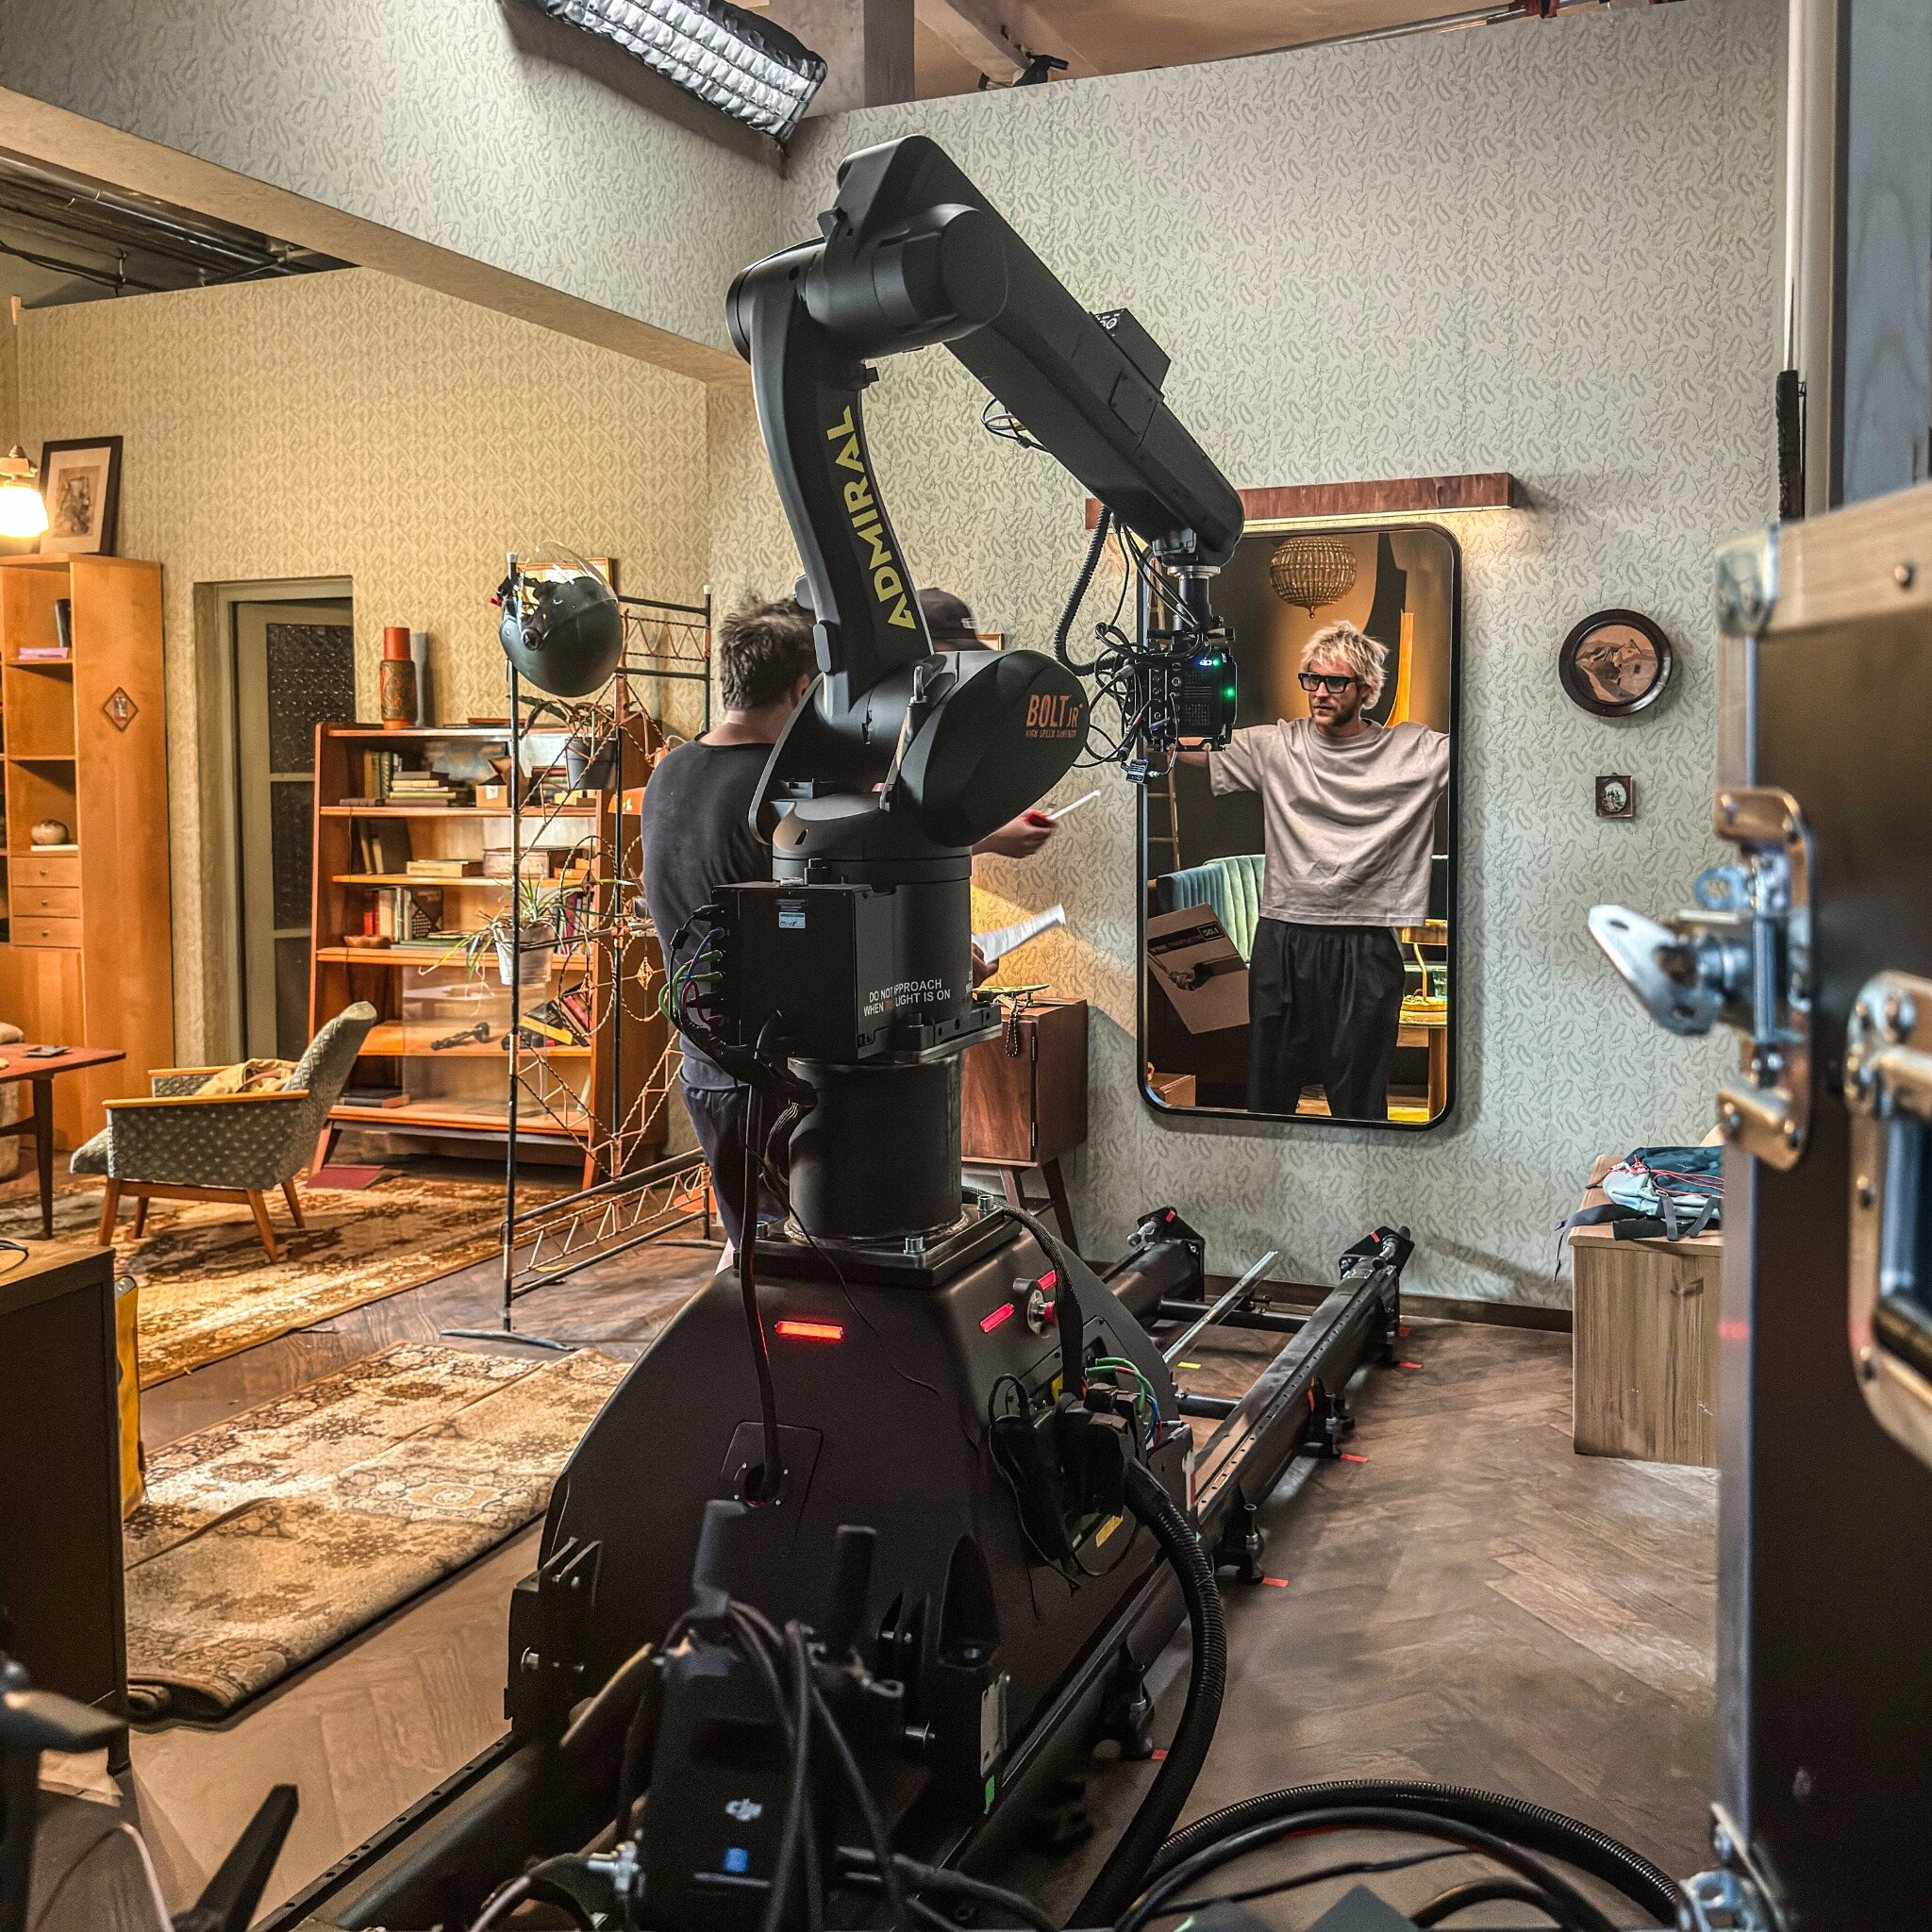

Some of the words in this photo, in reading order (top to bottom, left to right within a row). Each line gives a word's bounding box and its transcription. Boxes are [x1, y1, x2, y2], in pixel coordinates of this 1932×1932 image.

[826, 405, 916, 629] ADMIRAL
[1025, 694, 1072, 728] BOLT
[863, 1002, 884, 1017] WHEN
[895, 992, 921, 1007] LIGHT
[924, 991, 934, 1003] IS
[937, 989, 951, 1001] ON
[869, 991, 880, 1003] DO
[880, 987, 893, 1001] NOT
